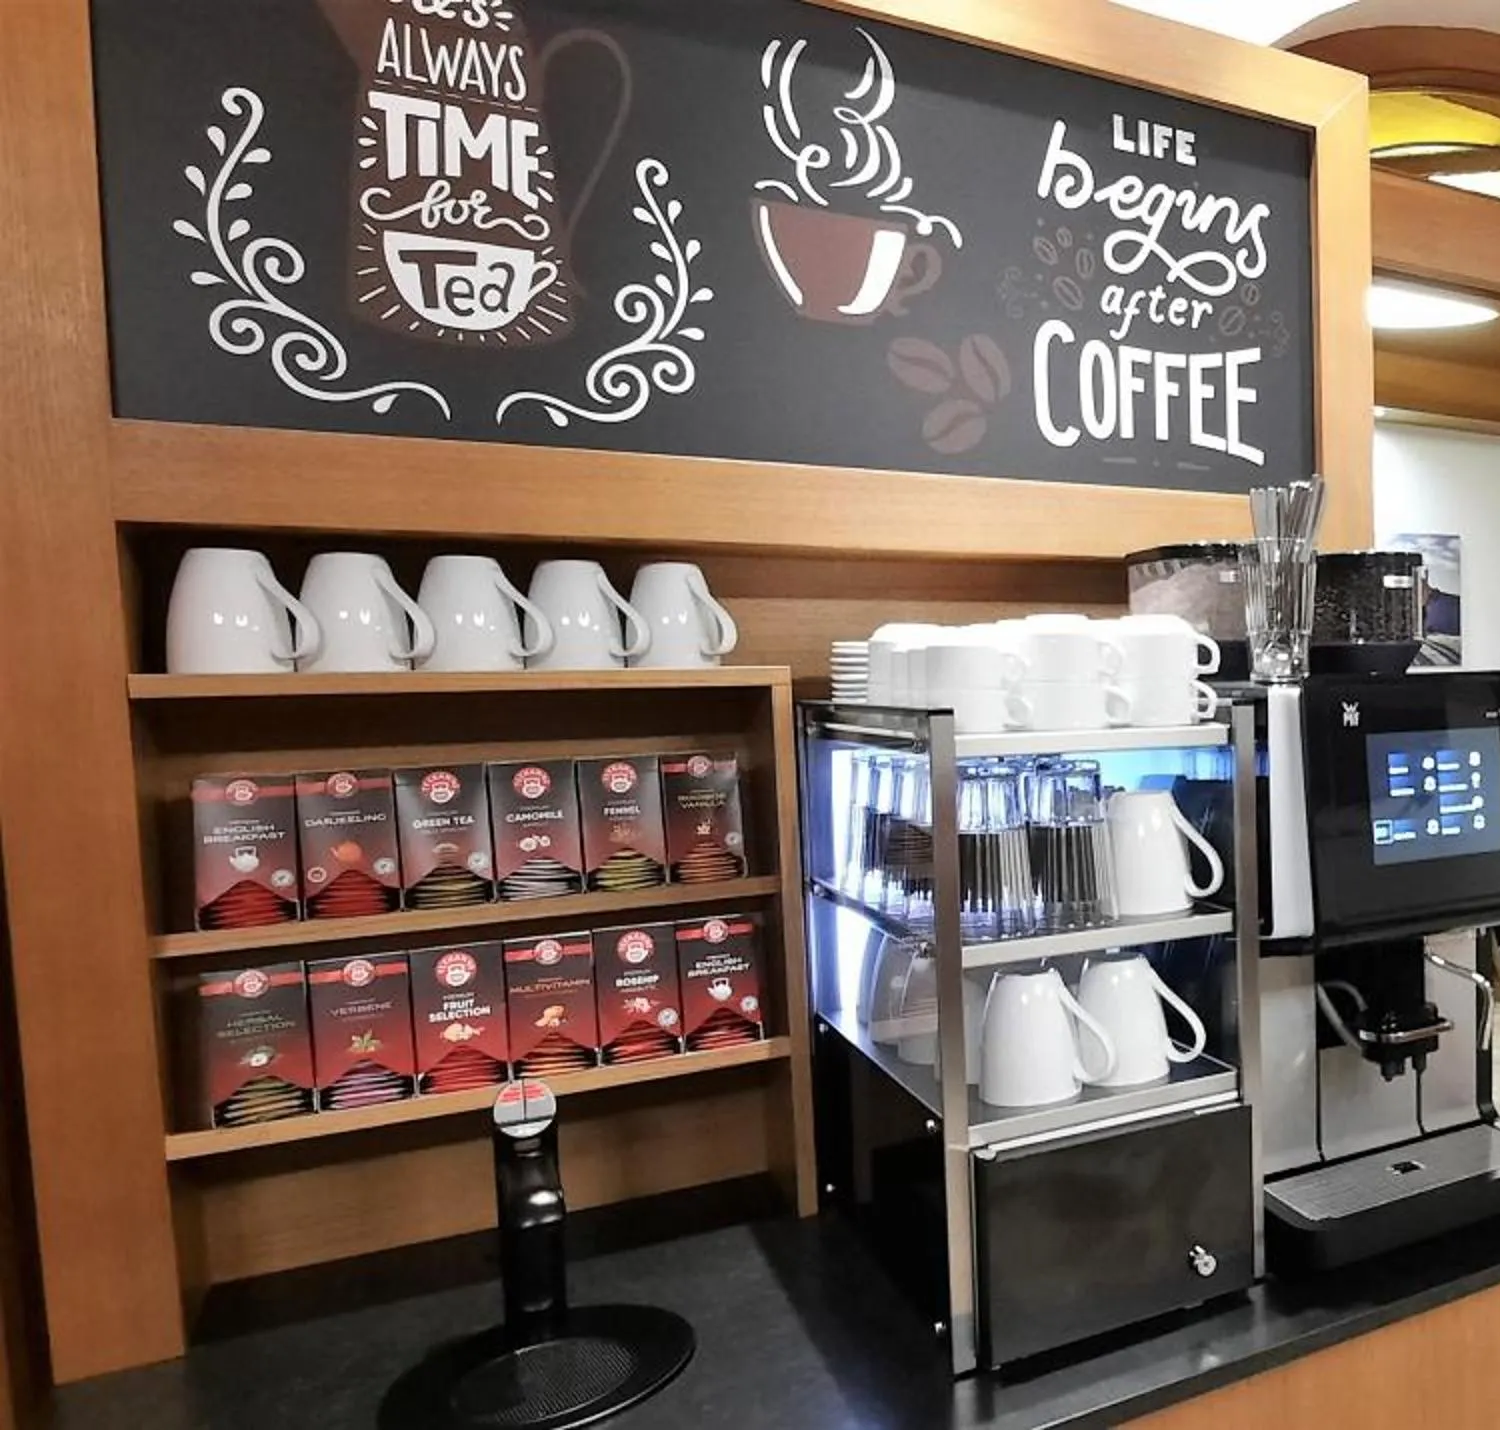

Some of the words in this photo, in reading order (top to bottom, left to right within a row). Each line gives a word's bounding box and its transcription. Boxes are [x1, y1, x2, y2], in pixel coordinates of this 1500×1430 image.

[377, 18, 527, 101] ALWAYS
[1112, 113, 1197, 166] LIFE
[368, 91, 539, 209] TIME
[1037, 119, 1270, 296] begins
[399, 248, 513, 313] Tea
[1101, 285, 1212, 340] after
[1033, 319, 1265, 466] COFFEE
[303, 812, 387, 827] DARJEELING
[603, 805, 641, 816] FENNEL
[212, 824, 275, 835] ENGLISH
[413, 818, 451, 829] GREEN
[453, 815, 476, 825] TEA
[203, 831, 286, 845] BREAKFAST
[687, 962, 751, 978] BREAKFAST
[695, 957, 742, 970] ENGLISH
[428, 1005, 491, 1023] SELECTION
[443, 999, 475, 1011] FRUIT
[216, 1020, 296, 1038] SELECTION
